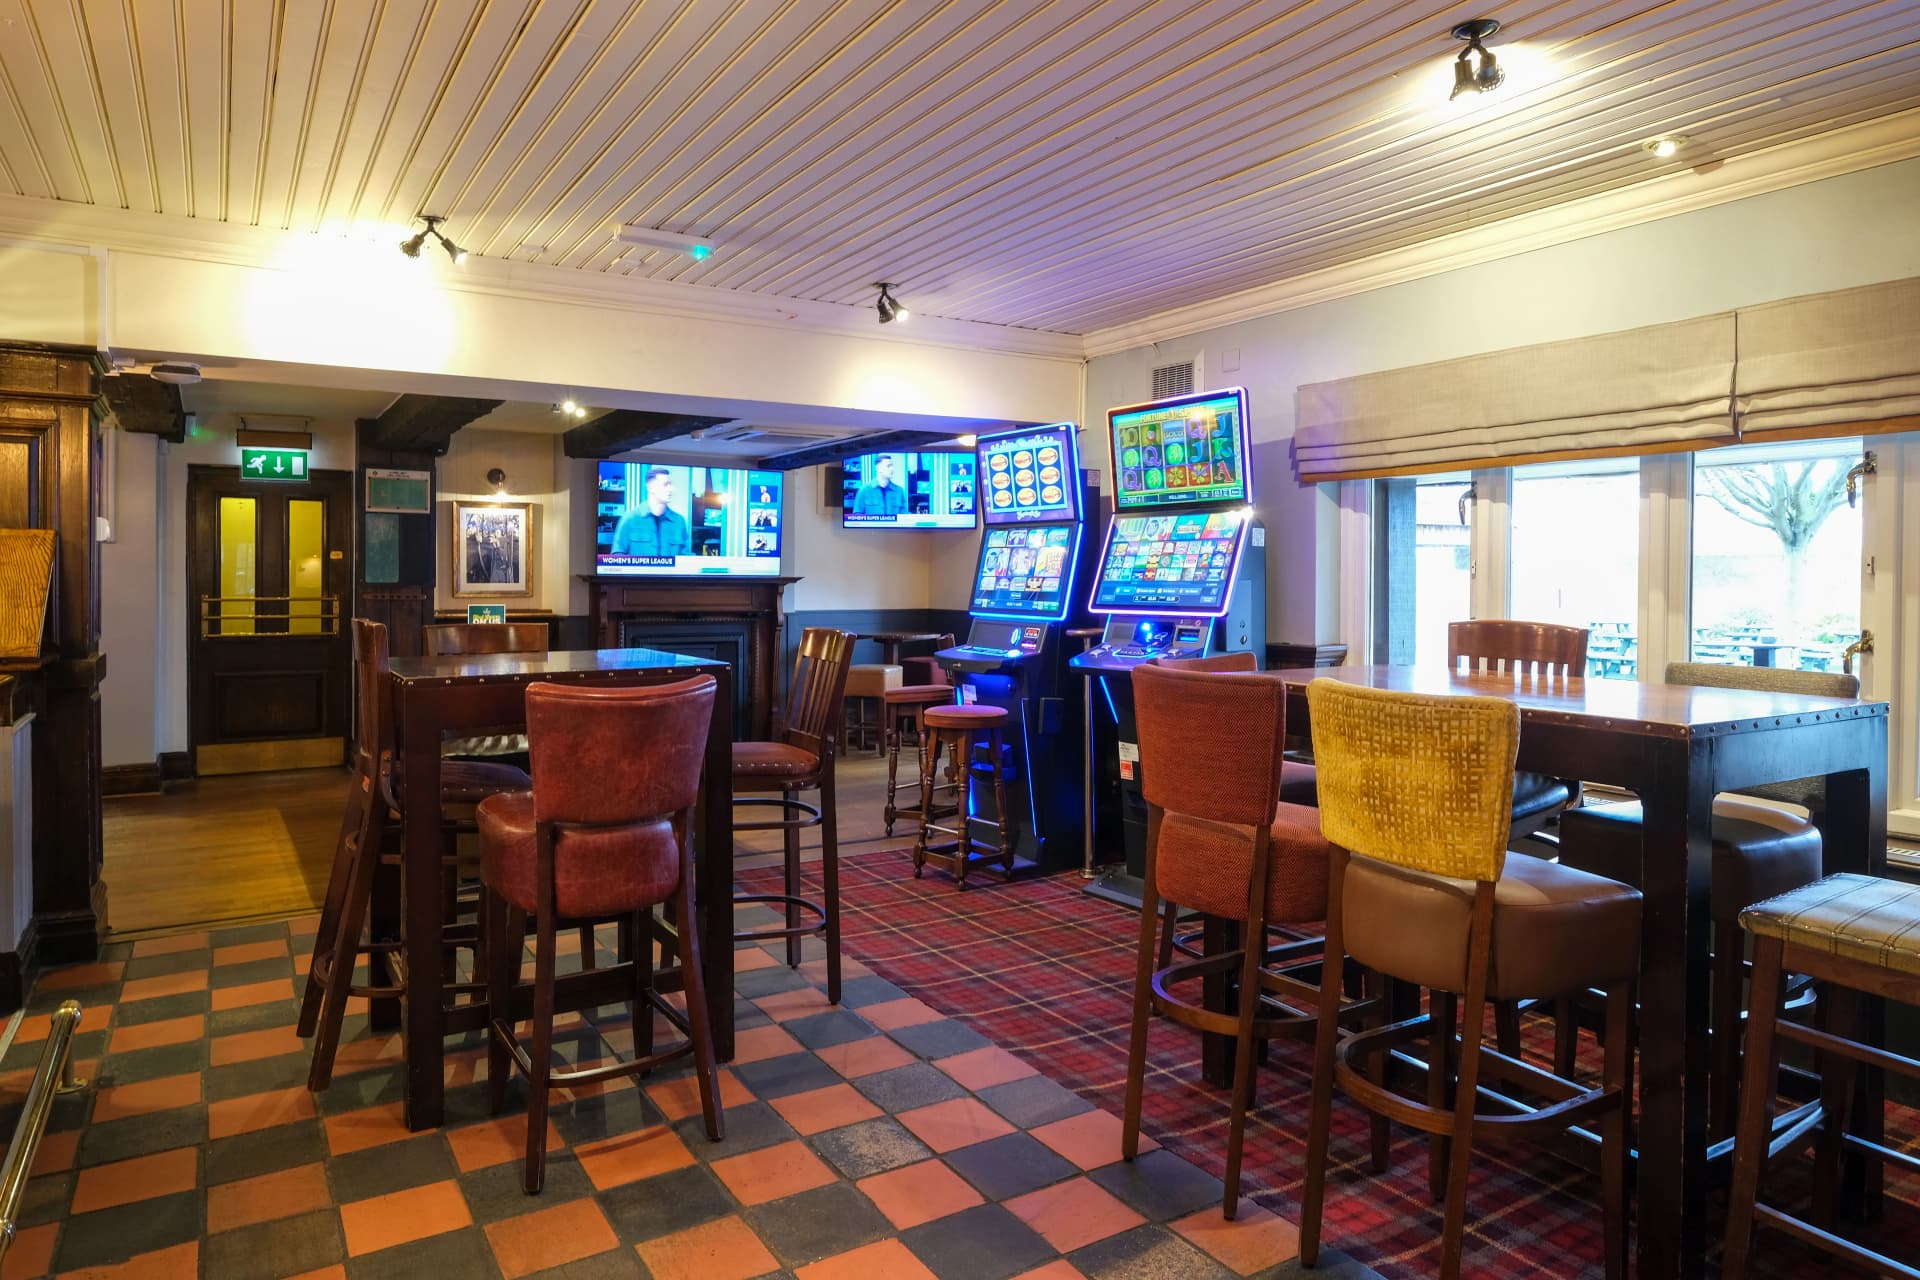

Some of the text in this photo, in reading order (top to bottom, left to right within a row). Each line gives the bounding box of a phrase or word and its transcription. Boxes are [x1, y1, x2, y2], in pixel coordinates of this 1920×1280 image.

[1143, 446, 1161, 466] Q
[1190, 440, 1204, 462] J
[1123, 460, 1234, 490] Q A
